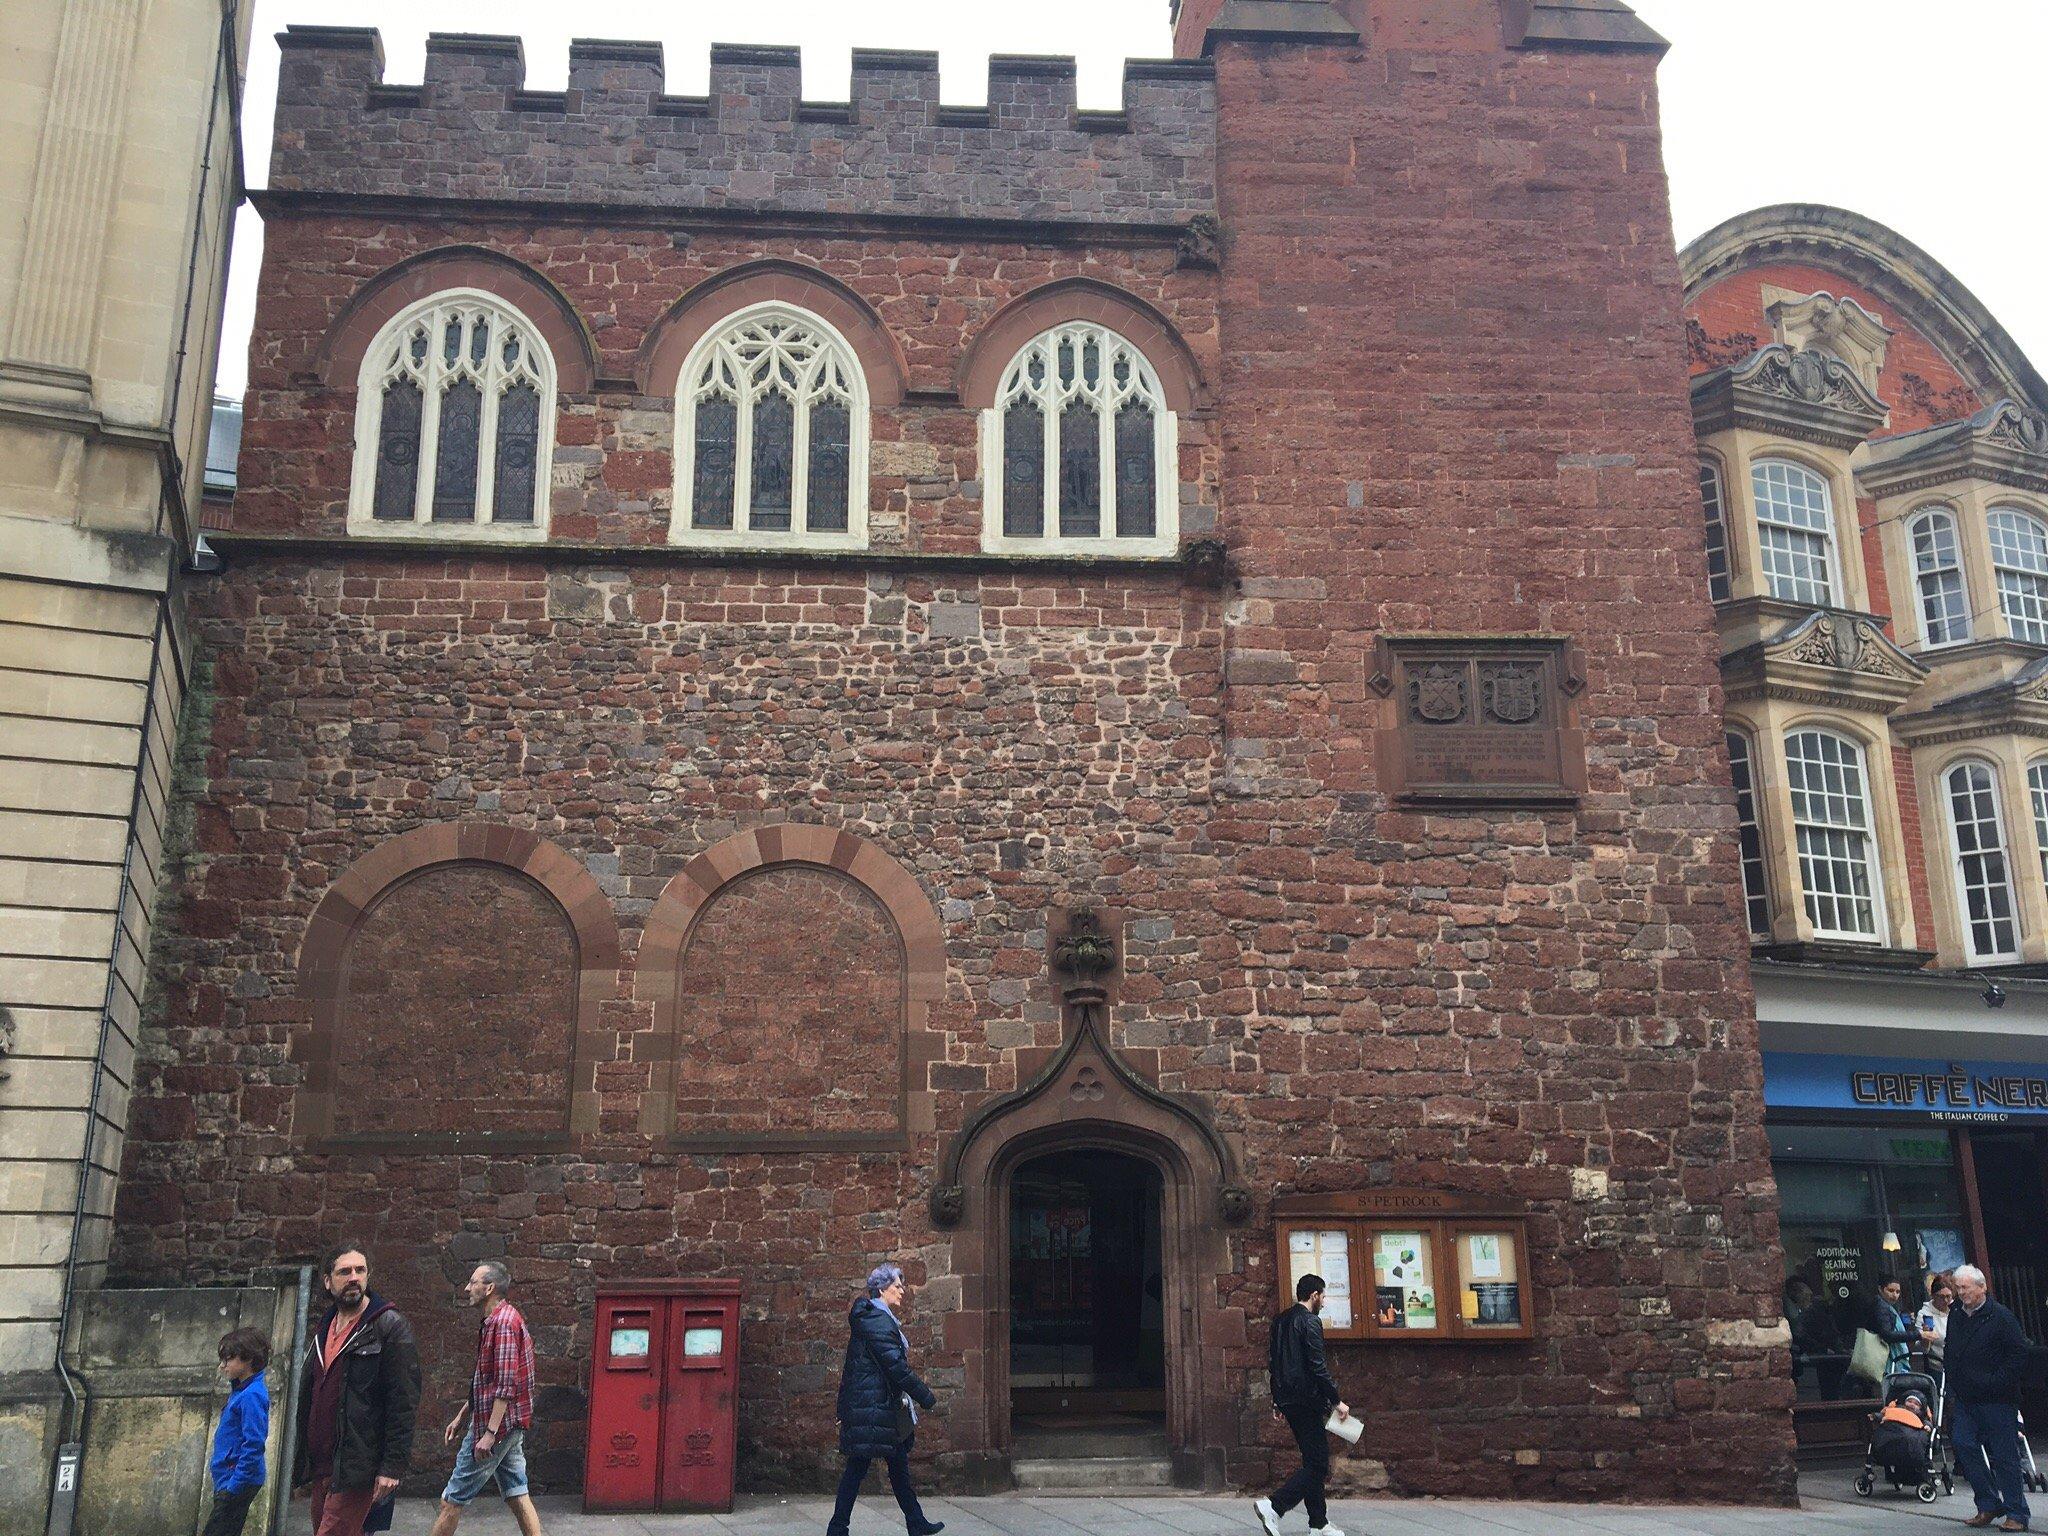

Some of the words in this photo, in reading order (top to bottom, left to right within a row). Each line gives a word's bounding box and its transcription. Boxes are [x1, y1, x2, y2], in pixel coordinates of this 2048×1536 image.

[1931, 1112, 1944, 1120] THE
[1945, 1112, 1972, 1120] ITALIAN
[1973, 1113, 1998, 1121] COFFEE
[1375, 1196, 1441, 1206] PETROCK
[1816, 1247, 1861, 1257] ADDITIONAL
[1824, 1259, 1856, 1269] SEATING
[1825, 1271, 1859, 1281] UPSTAIRS
